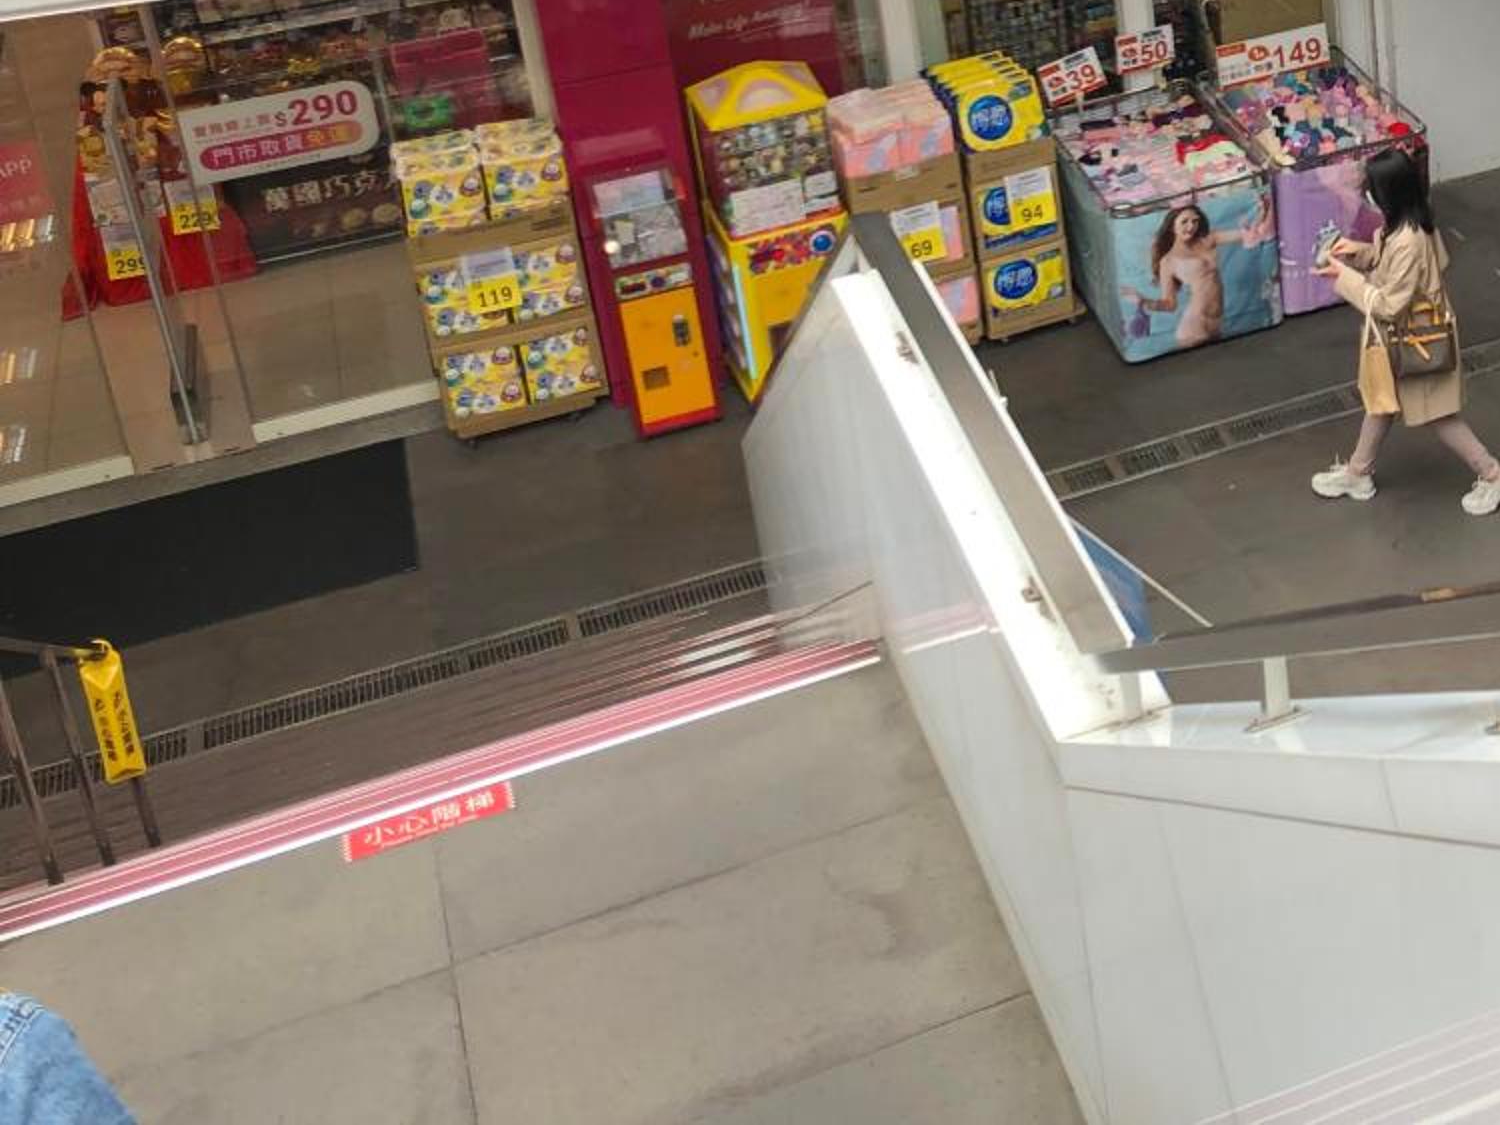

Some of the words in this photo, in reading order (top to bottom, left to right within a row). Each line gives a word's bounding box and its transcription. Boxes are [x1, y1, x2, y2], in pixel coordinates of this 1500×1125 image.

[1140, 40, 1169, 63] 50
[1273, 37, 1321, 69] 149
[1020, 204, 1044, 223] 94
[910, 240, 933, 259] 69
[478, 286, 513, 307] 119
